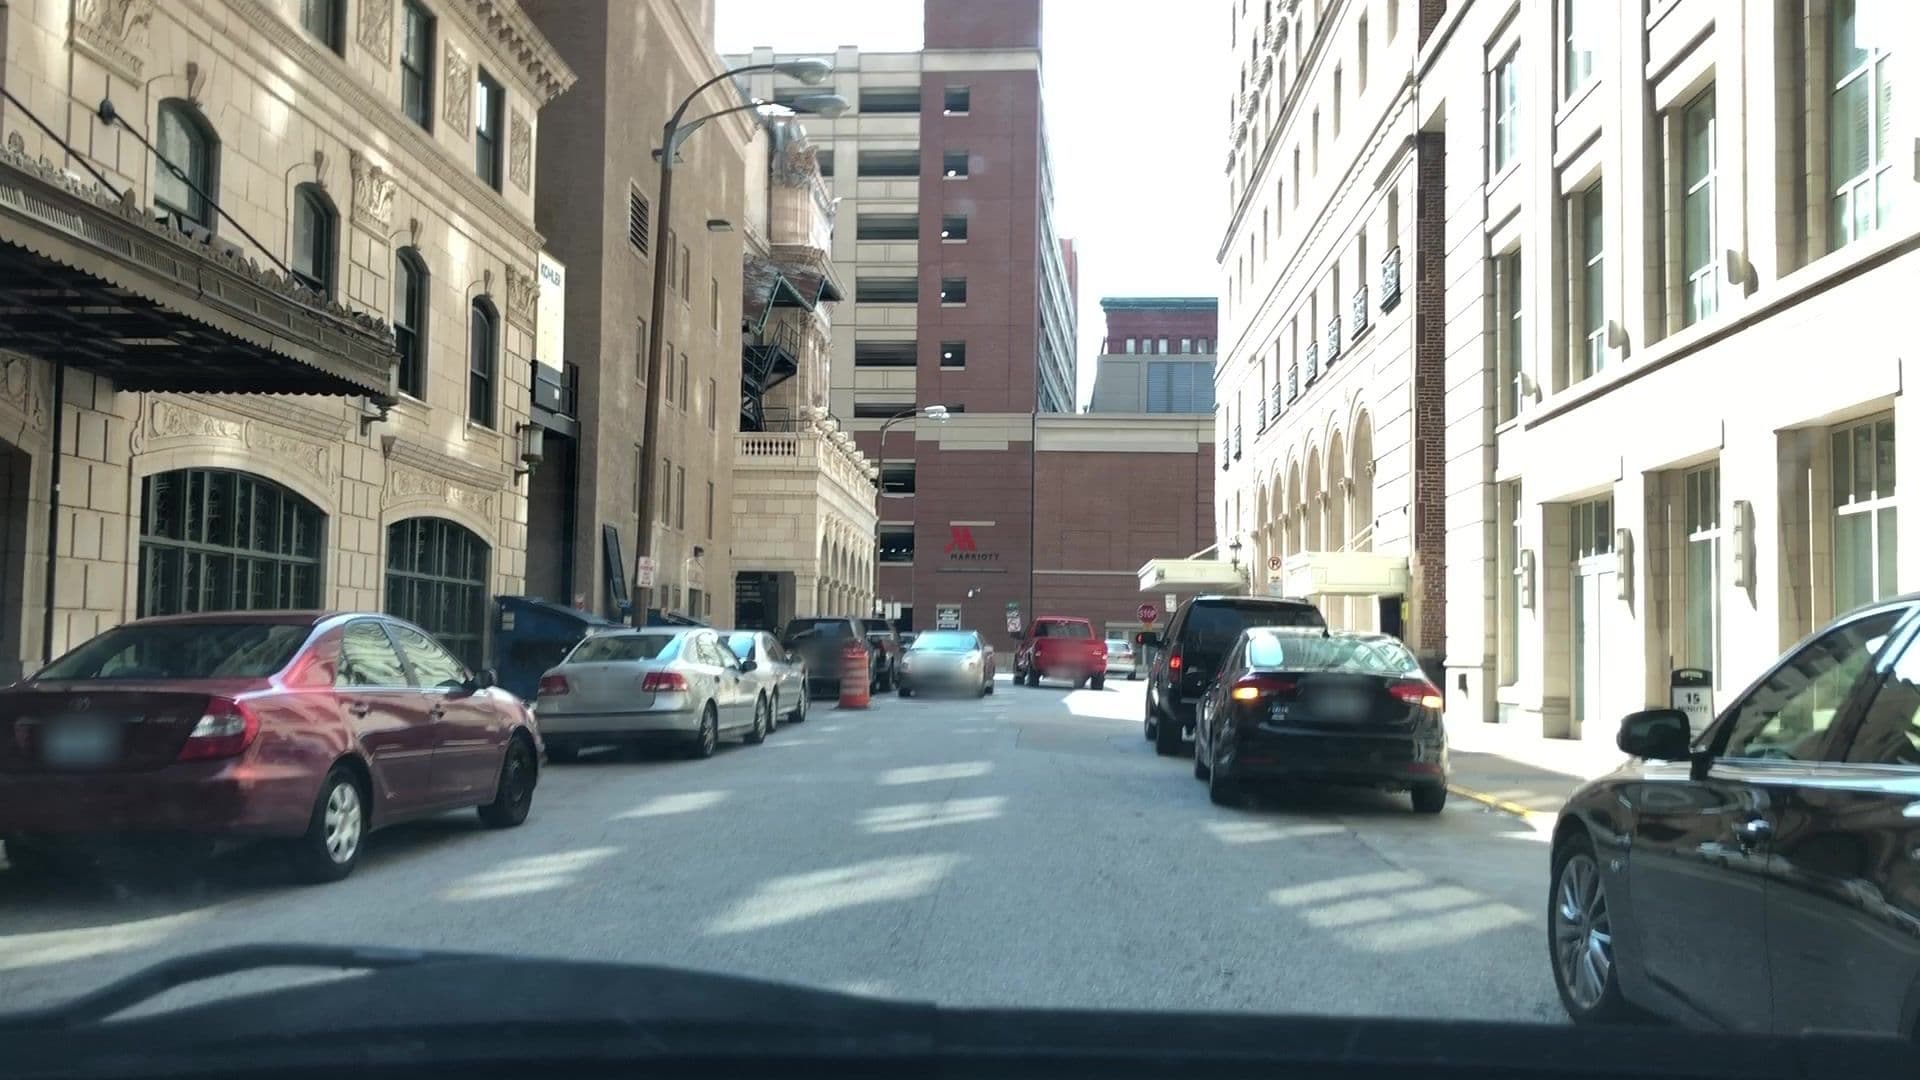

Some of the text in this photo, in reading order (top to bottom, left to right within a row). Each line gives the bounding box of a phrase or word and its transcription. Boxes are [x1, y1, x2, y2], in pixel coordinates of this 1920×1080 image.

[540, 263, 561, 287] KOHLER
[950, 552, 1000, 561] MARRIOTT
[1139, 608, 1157, 619] STOP
[1685, 693, 1700, 705] 15
